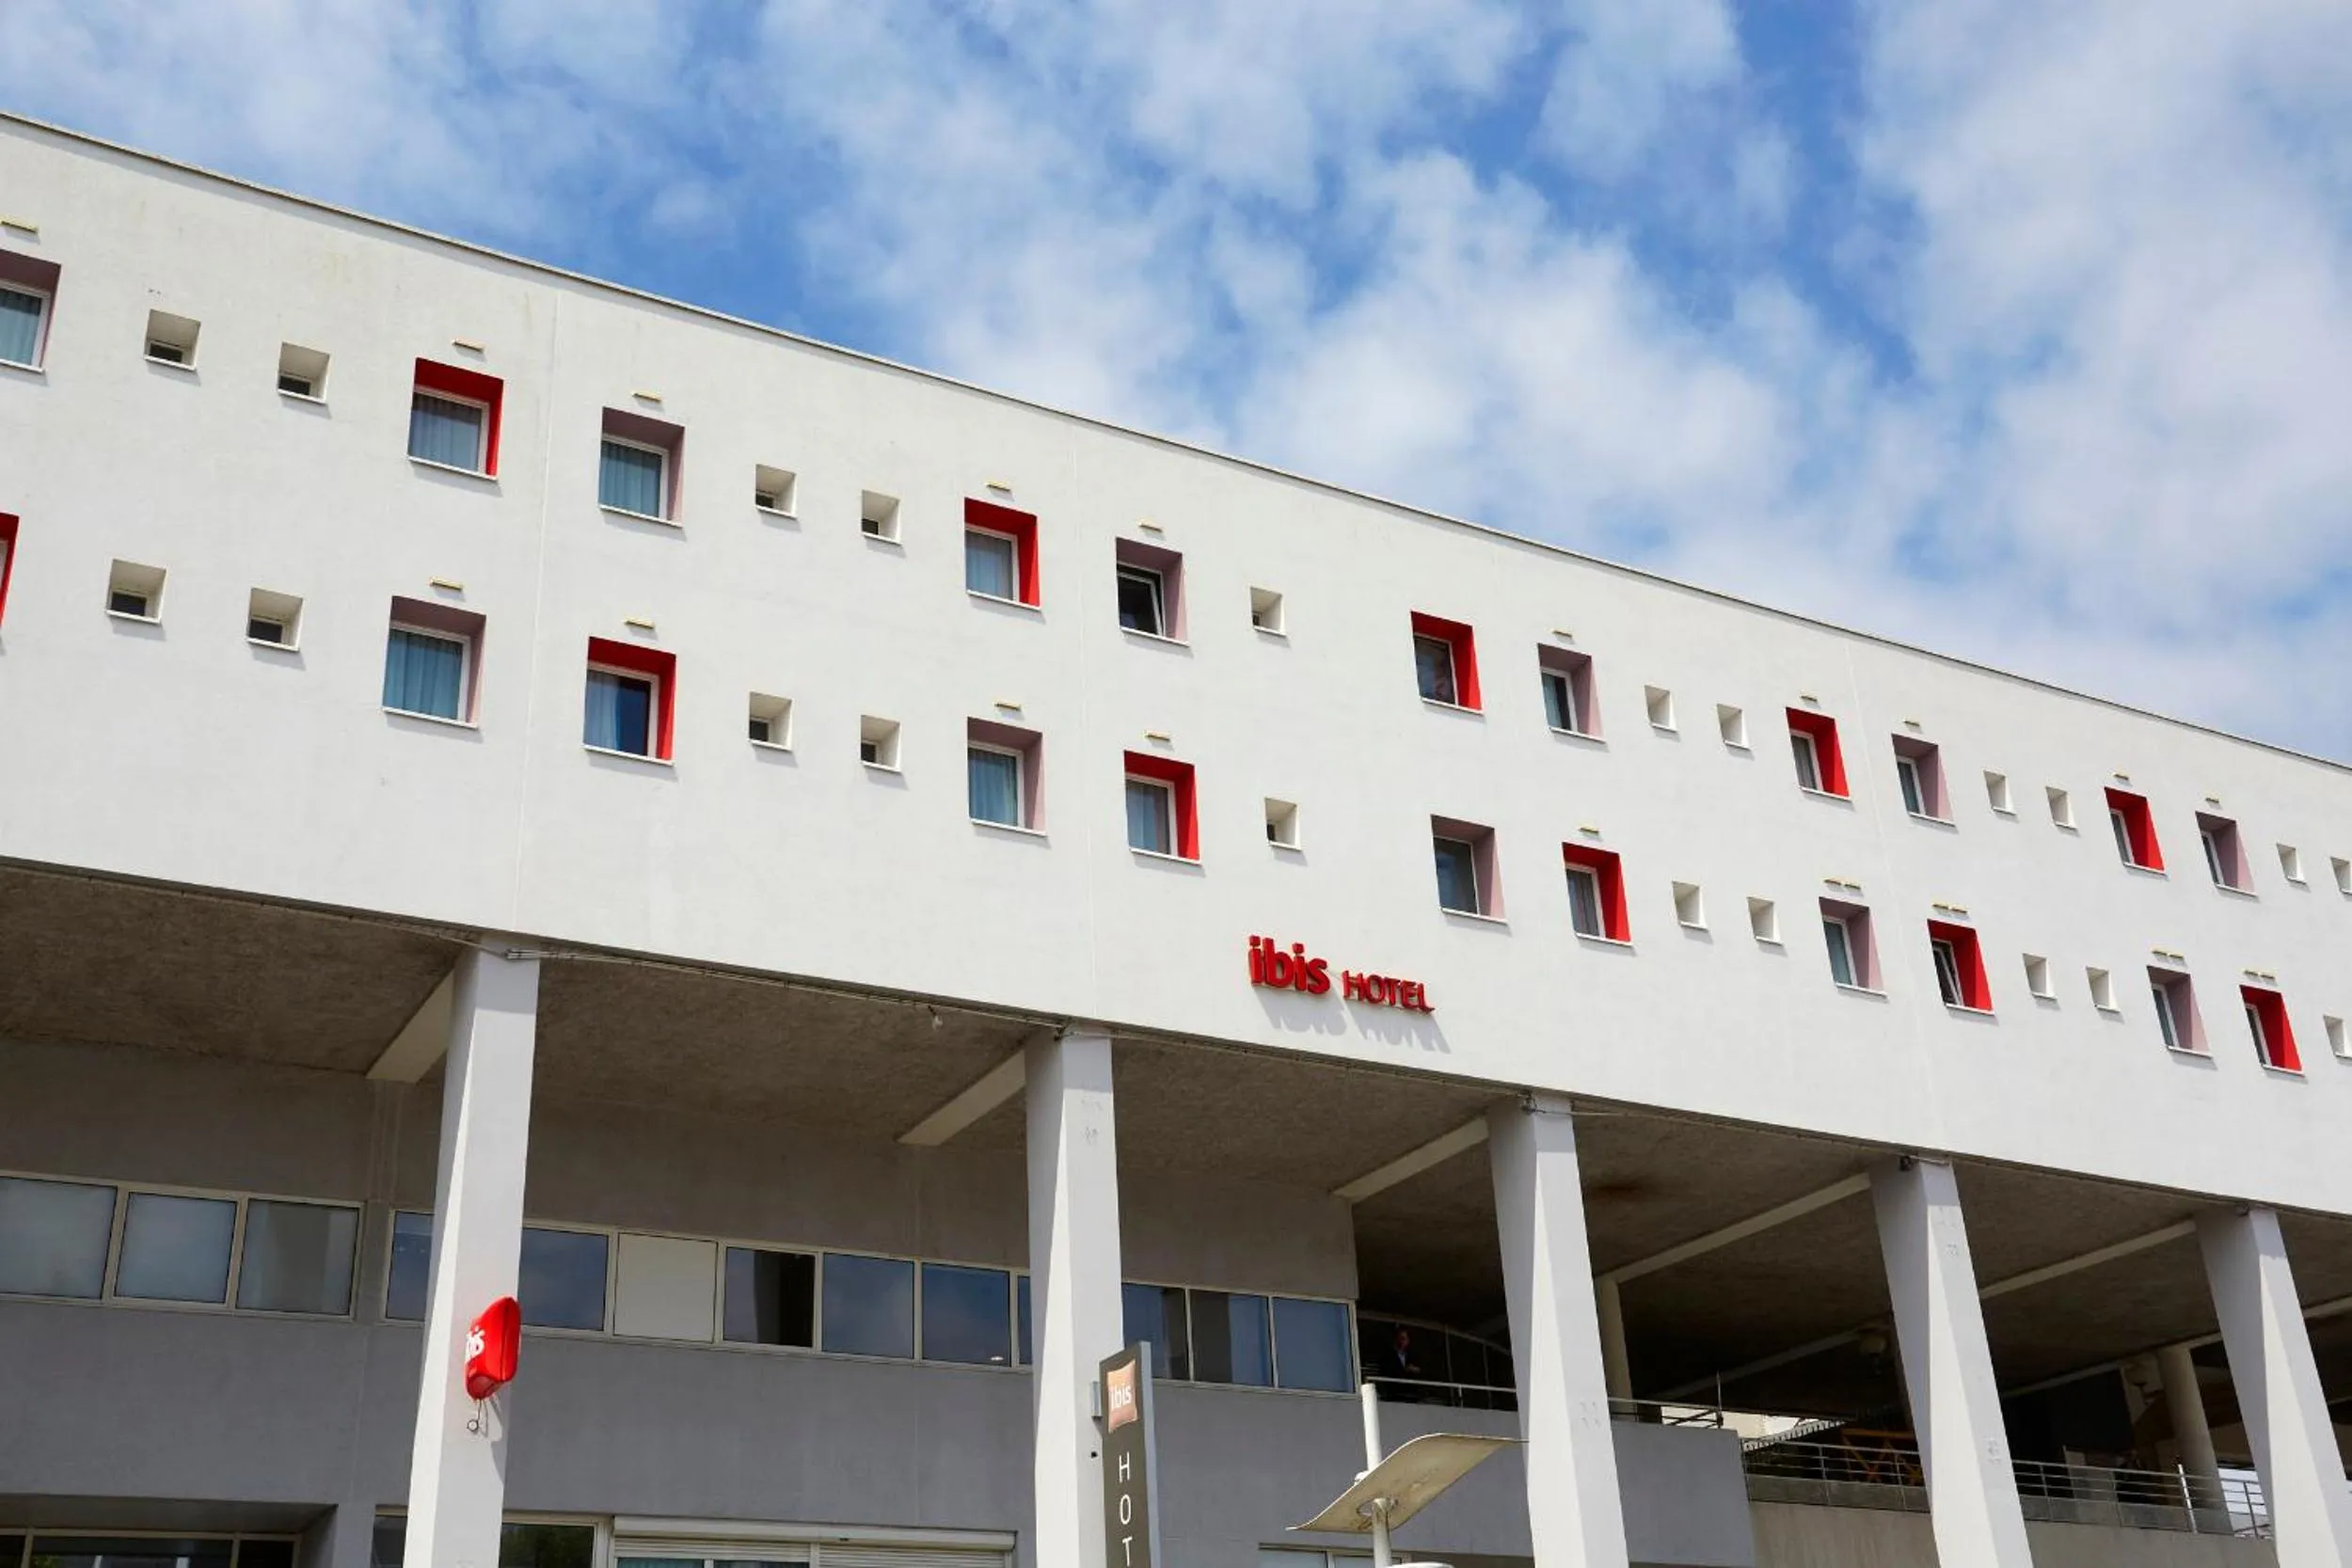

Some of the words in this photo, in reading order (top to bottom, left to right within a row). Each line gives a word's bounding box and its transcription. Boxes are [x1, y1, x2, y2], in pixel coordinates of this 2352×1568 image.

[1248, 935, 1330, 994] ibis
[1342, 970, 1435, 1013] HOTEL
[1108, 1384, 1132, 1409] ibis
